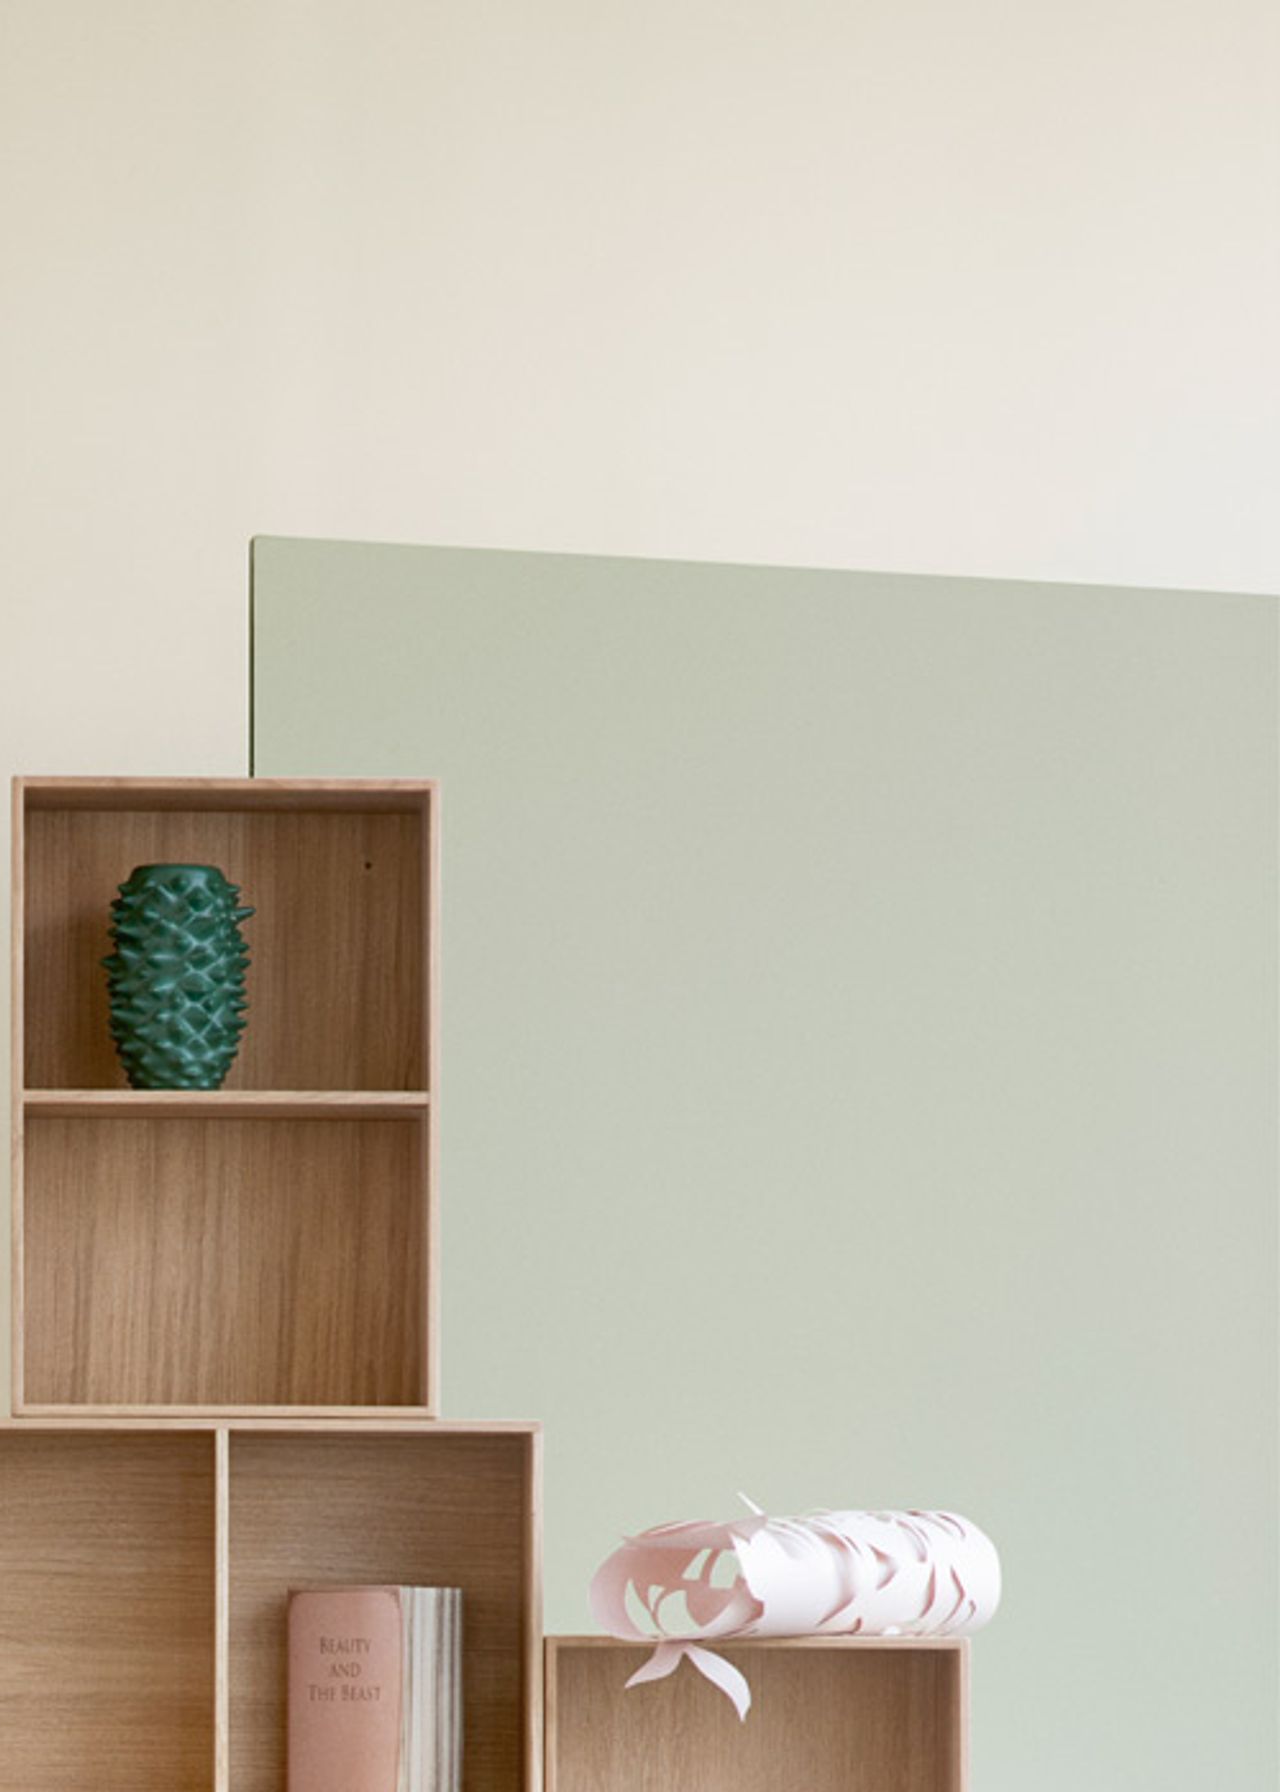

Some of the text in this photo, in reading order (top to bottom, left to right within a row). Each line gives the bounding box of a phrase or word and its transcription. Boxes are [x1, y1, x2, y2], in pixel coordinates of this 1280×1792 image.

[319, 1637, 372, 1655] BEAUTY
[329, 1662, 362, 1679] AND
[308, 1684, 381, 1702] THE BEAST
